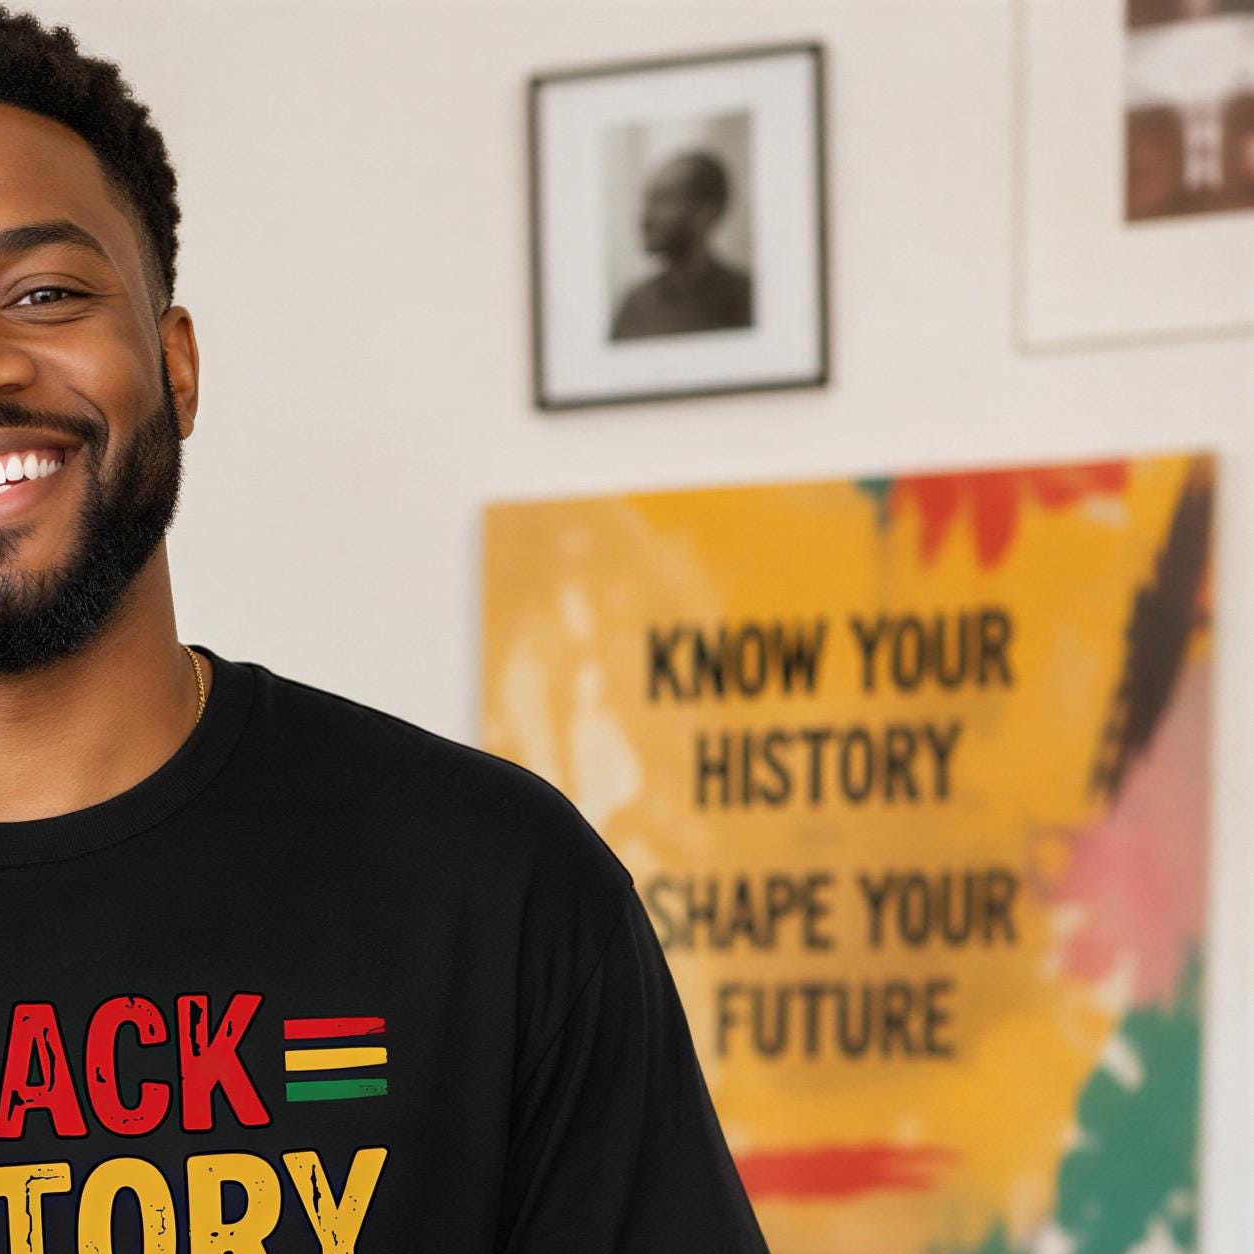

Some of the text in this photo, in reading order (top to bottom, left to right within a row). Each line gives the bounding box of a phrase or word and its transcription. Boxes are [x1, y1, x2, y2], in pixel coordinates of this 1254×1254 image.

[647, 607, 1013, 703] KNOW YOUR
[695, 719, 963, 809] HISTORY
[649, 867, 1019, 951] SHAPE YOUR
[715, 979, 955, 1062] FUTURE
